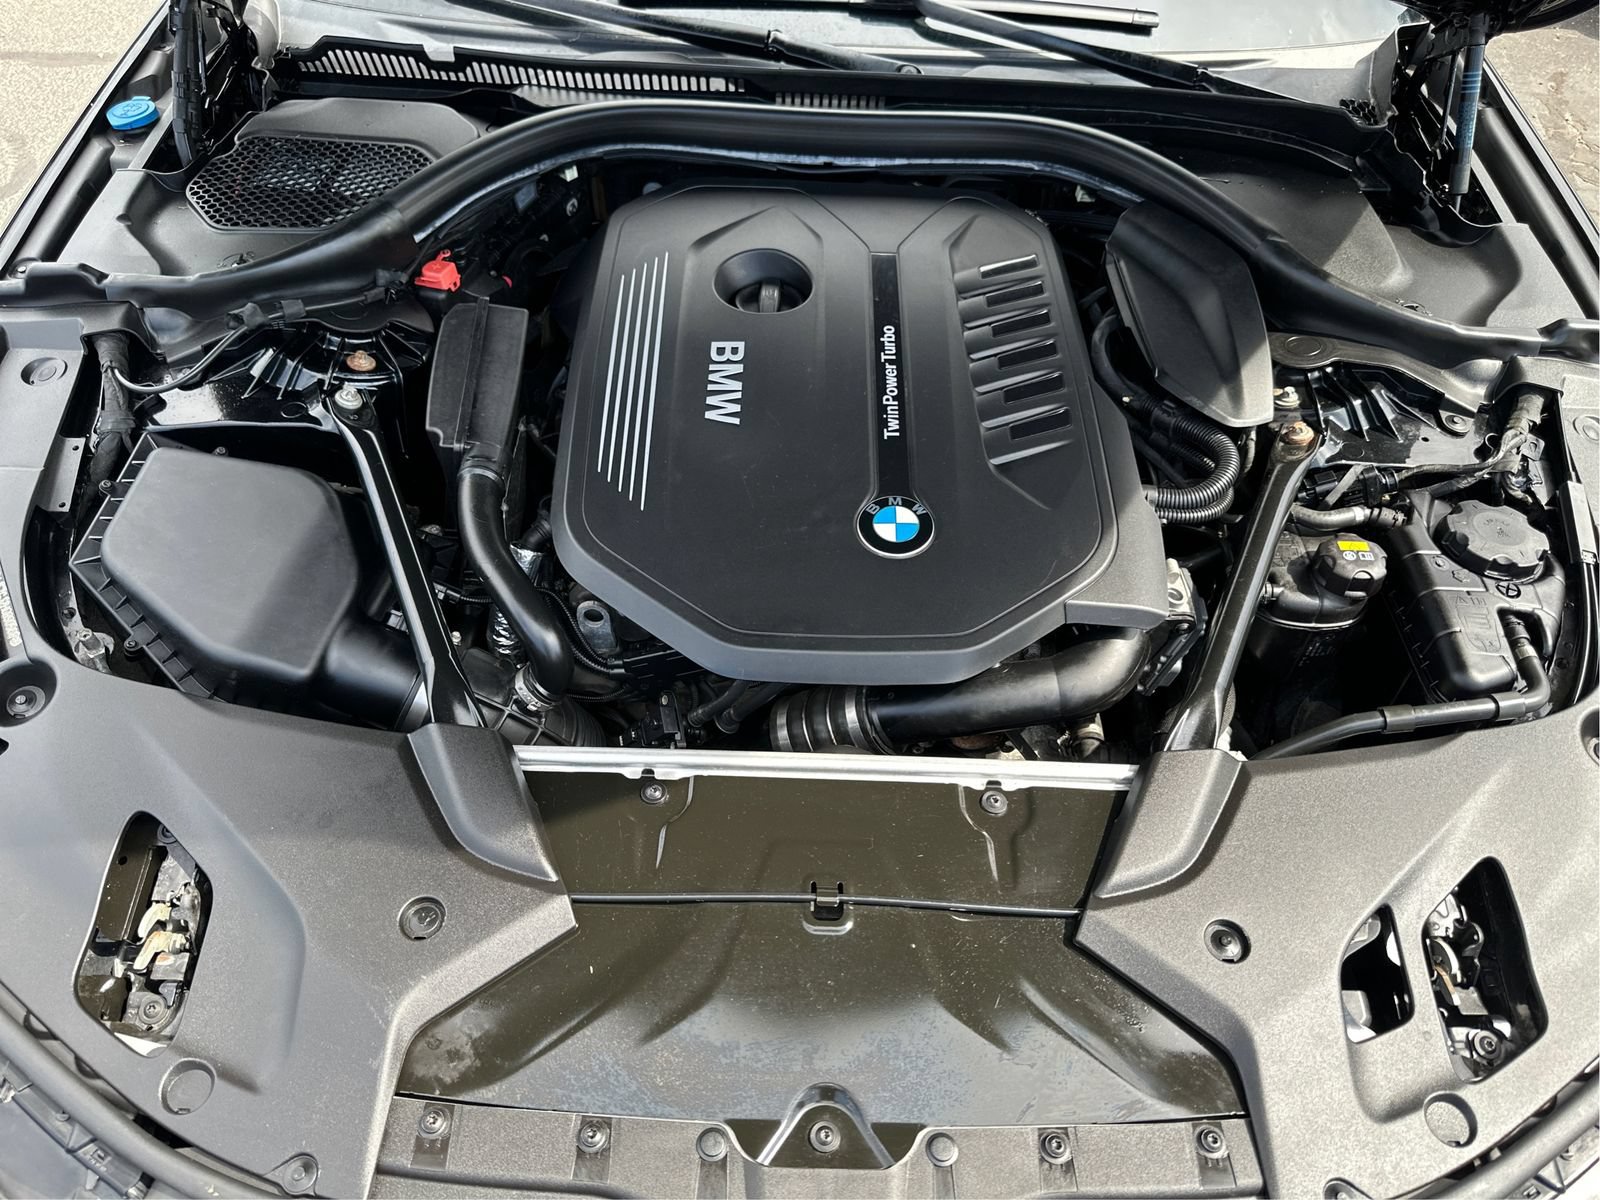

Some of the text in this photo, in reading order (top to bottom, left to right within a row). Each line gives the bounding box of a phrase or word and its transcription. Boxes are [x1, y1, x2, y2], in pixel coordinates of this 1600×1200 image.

[704, 341, 745, 425] BMW
[880, 325, 901, 440] TwinPower Turbo
[865, 496, 927, 516] BMW
